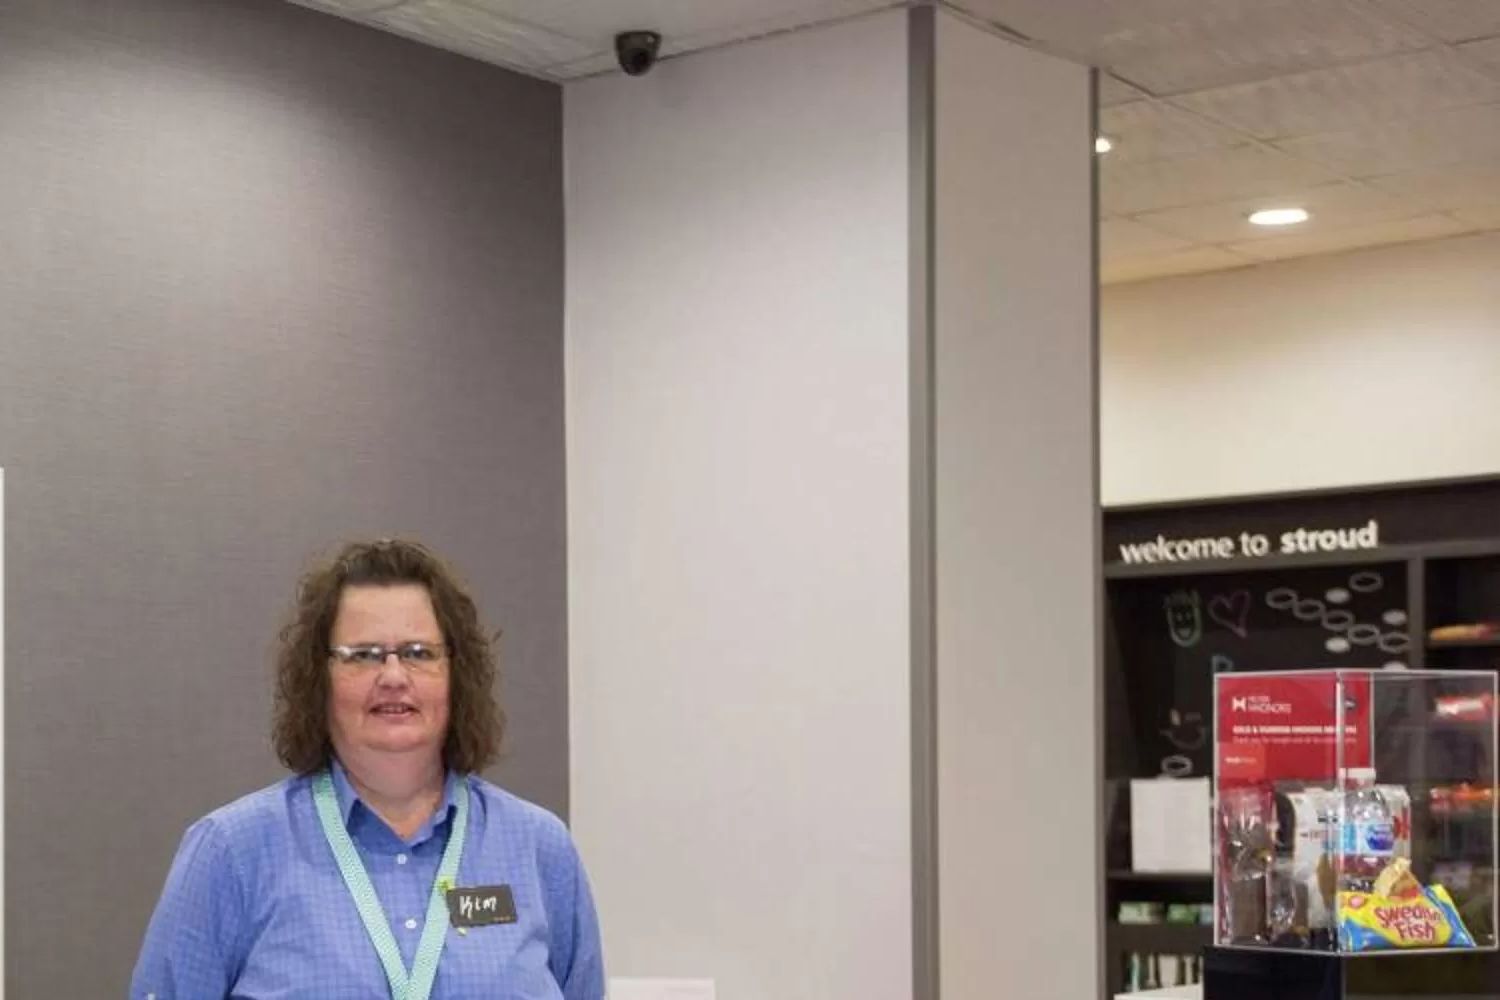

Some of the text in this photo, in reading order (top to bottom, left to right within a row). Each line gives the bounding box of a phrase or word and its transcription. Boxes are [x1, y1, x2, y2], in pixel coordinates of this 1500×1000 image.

[1119, 518, 1379, 564] welcome to stroud
[1393, 921, 1434, 940] Fish
